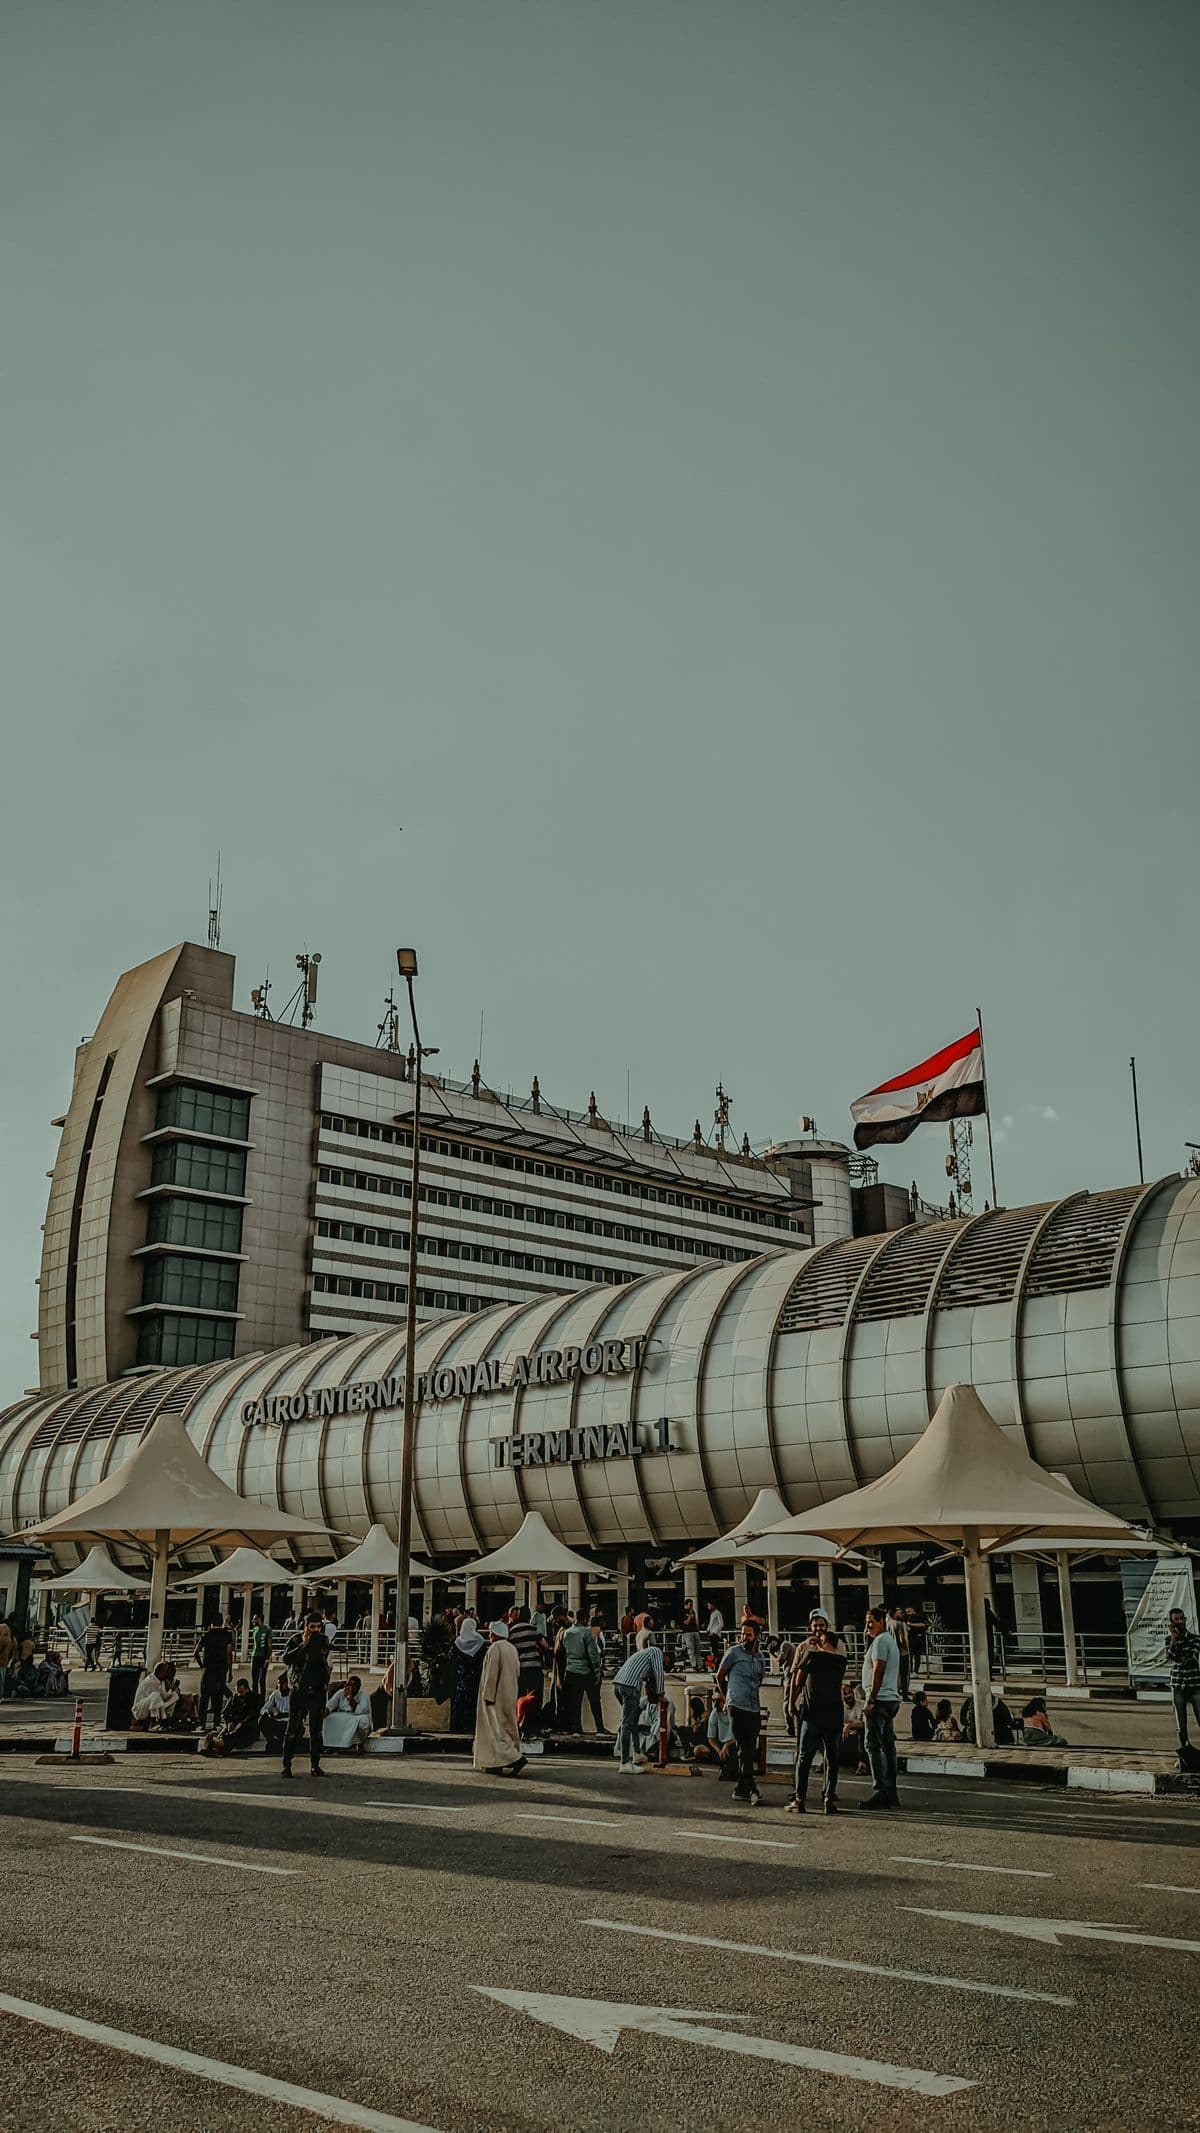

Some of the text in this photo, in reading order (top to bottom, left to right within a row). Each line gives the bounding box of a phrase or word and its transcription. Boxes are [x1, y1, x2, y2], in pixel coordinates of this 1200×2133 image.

[241, 1335, 648, 1426] CAIRO INTERNATIONAL AIRPORT
[489, 1417, 672, 1468] TERMINAL 1
